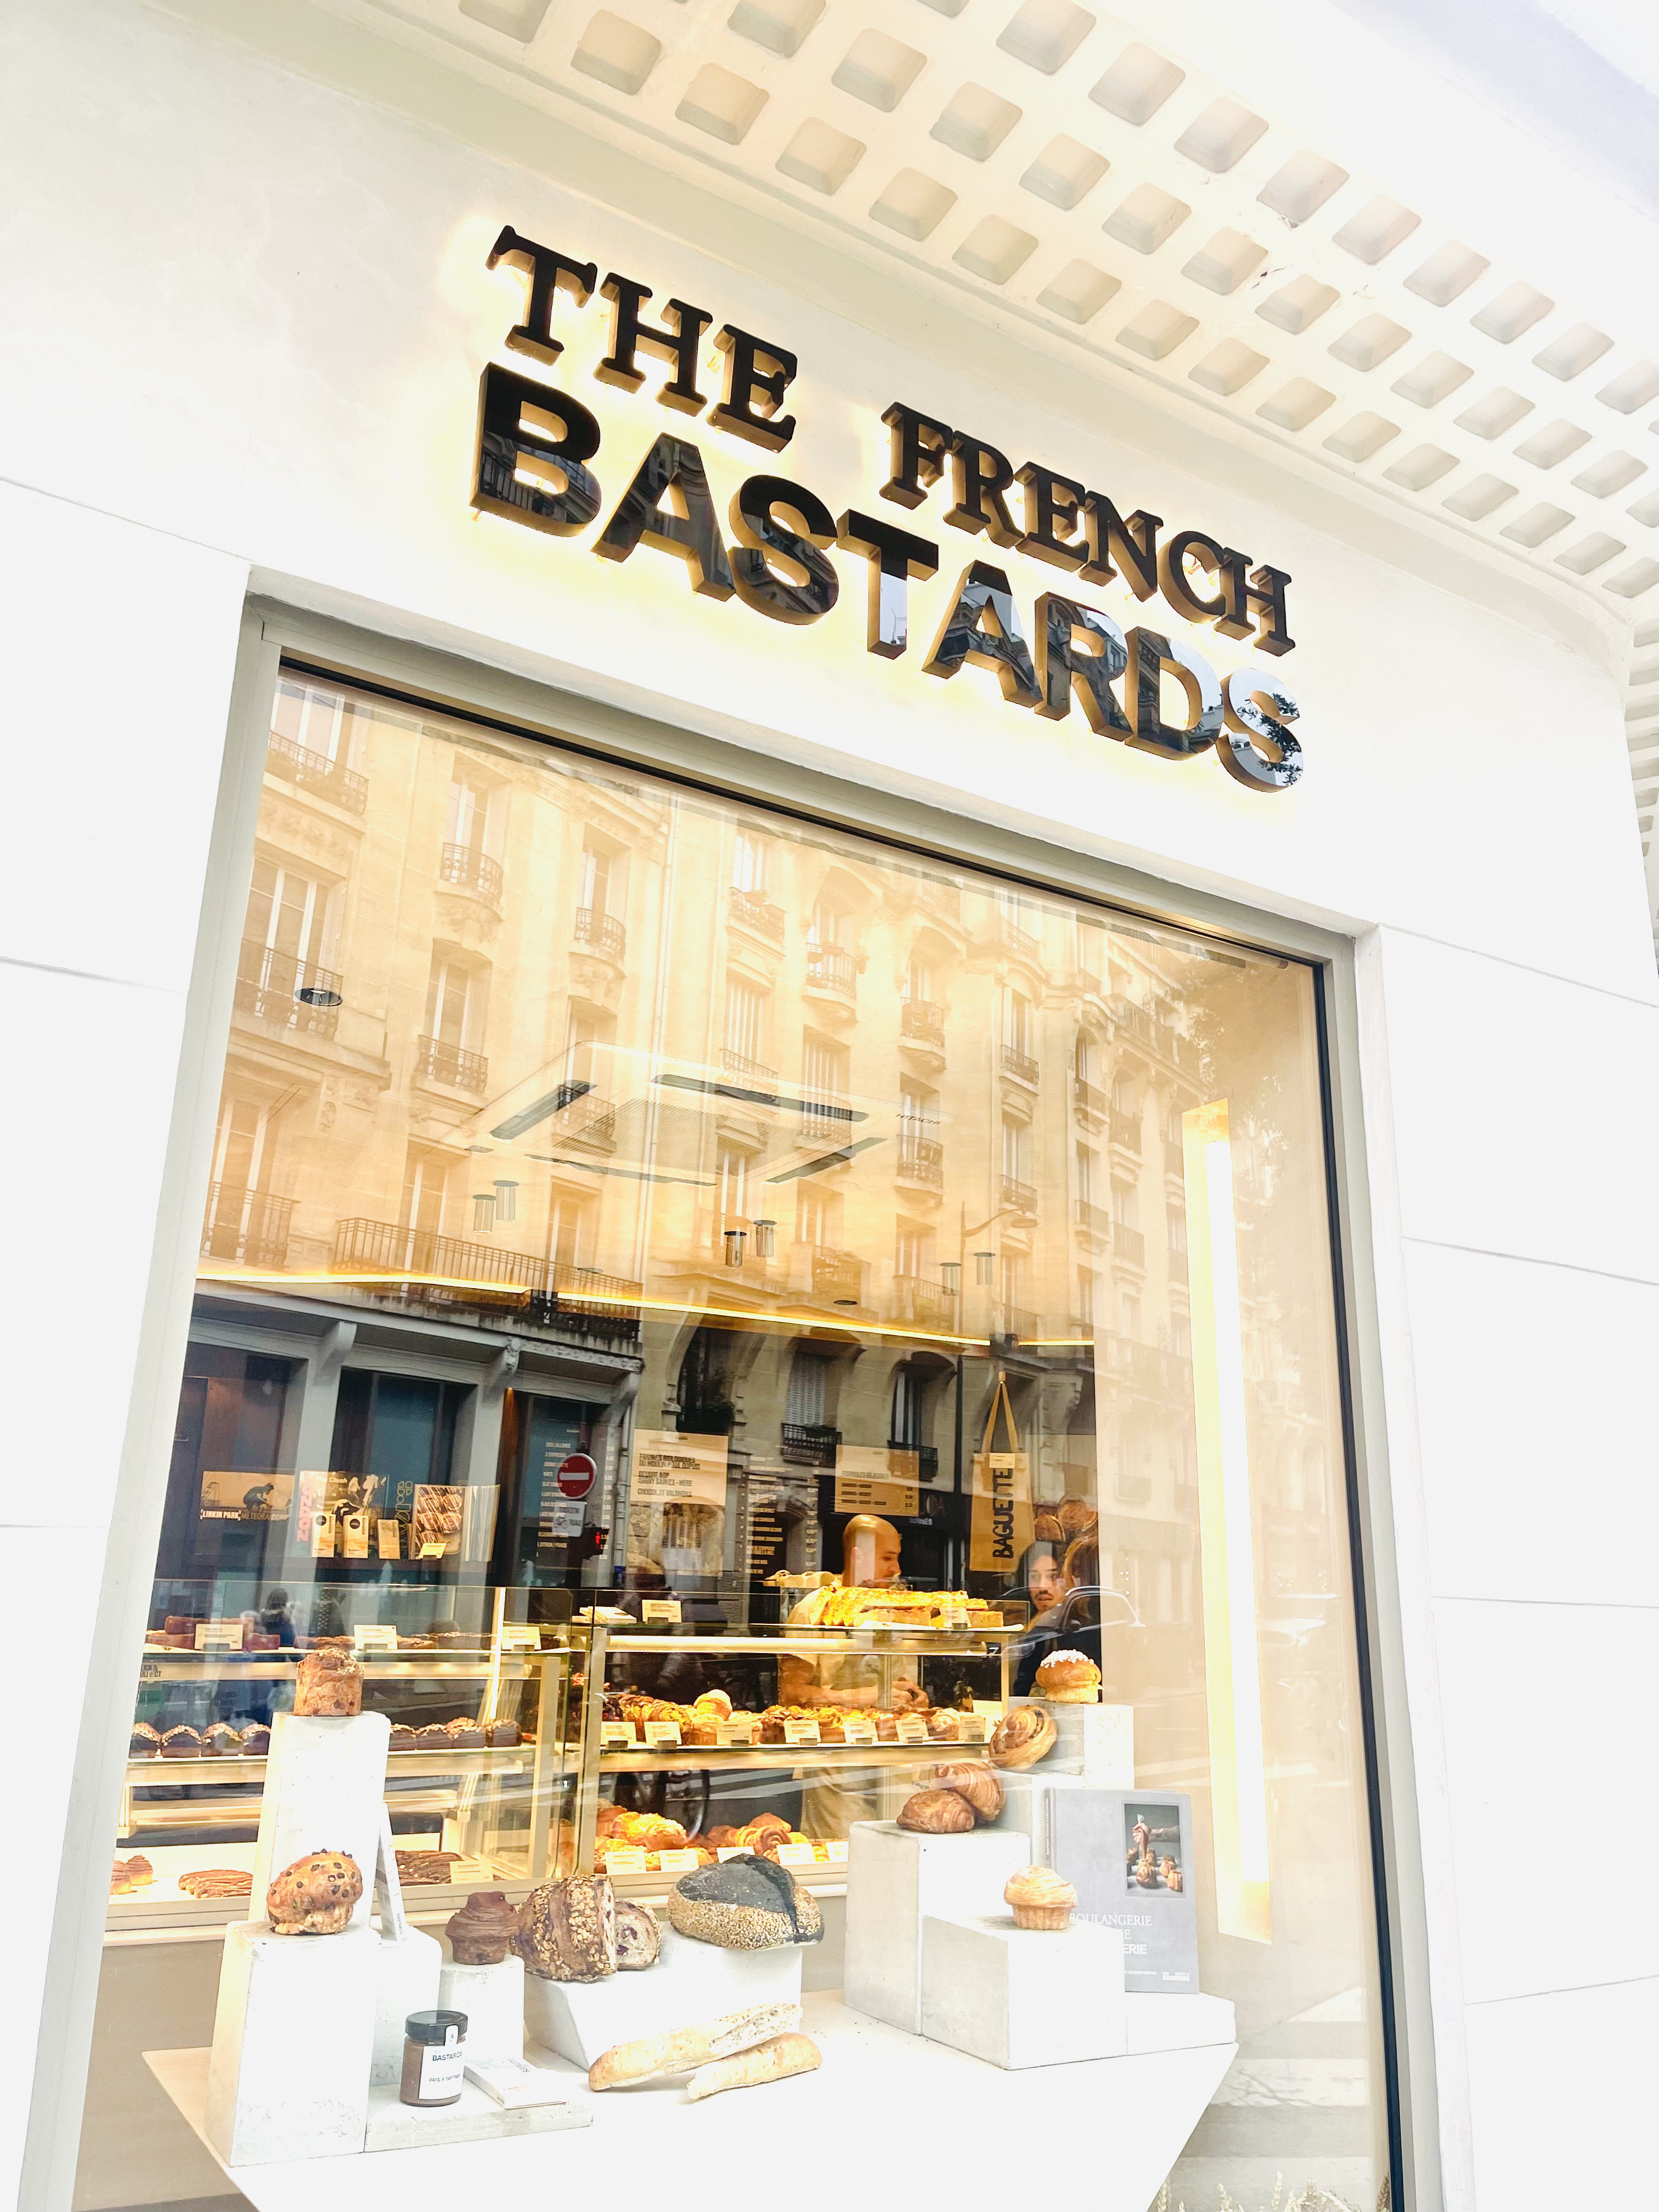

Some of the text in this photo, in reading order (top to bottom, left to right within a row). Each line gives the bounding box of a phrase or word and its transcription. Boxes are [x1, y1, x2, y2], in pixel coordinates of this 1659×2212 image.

[486, 225, 1295, 656] THE FRENCH
[469, 362, 1303, 793] BASTARDS
[895, 1114, 941, 1125] HITACHI
[241, 1511, 269, 1521] METEORA
[296, 1473, 314, 1542] ONDON
[992, 1468, 1014, 1559] BAGUETTE
[432, 2050, 462, 2061] BASTARDS
